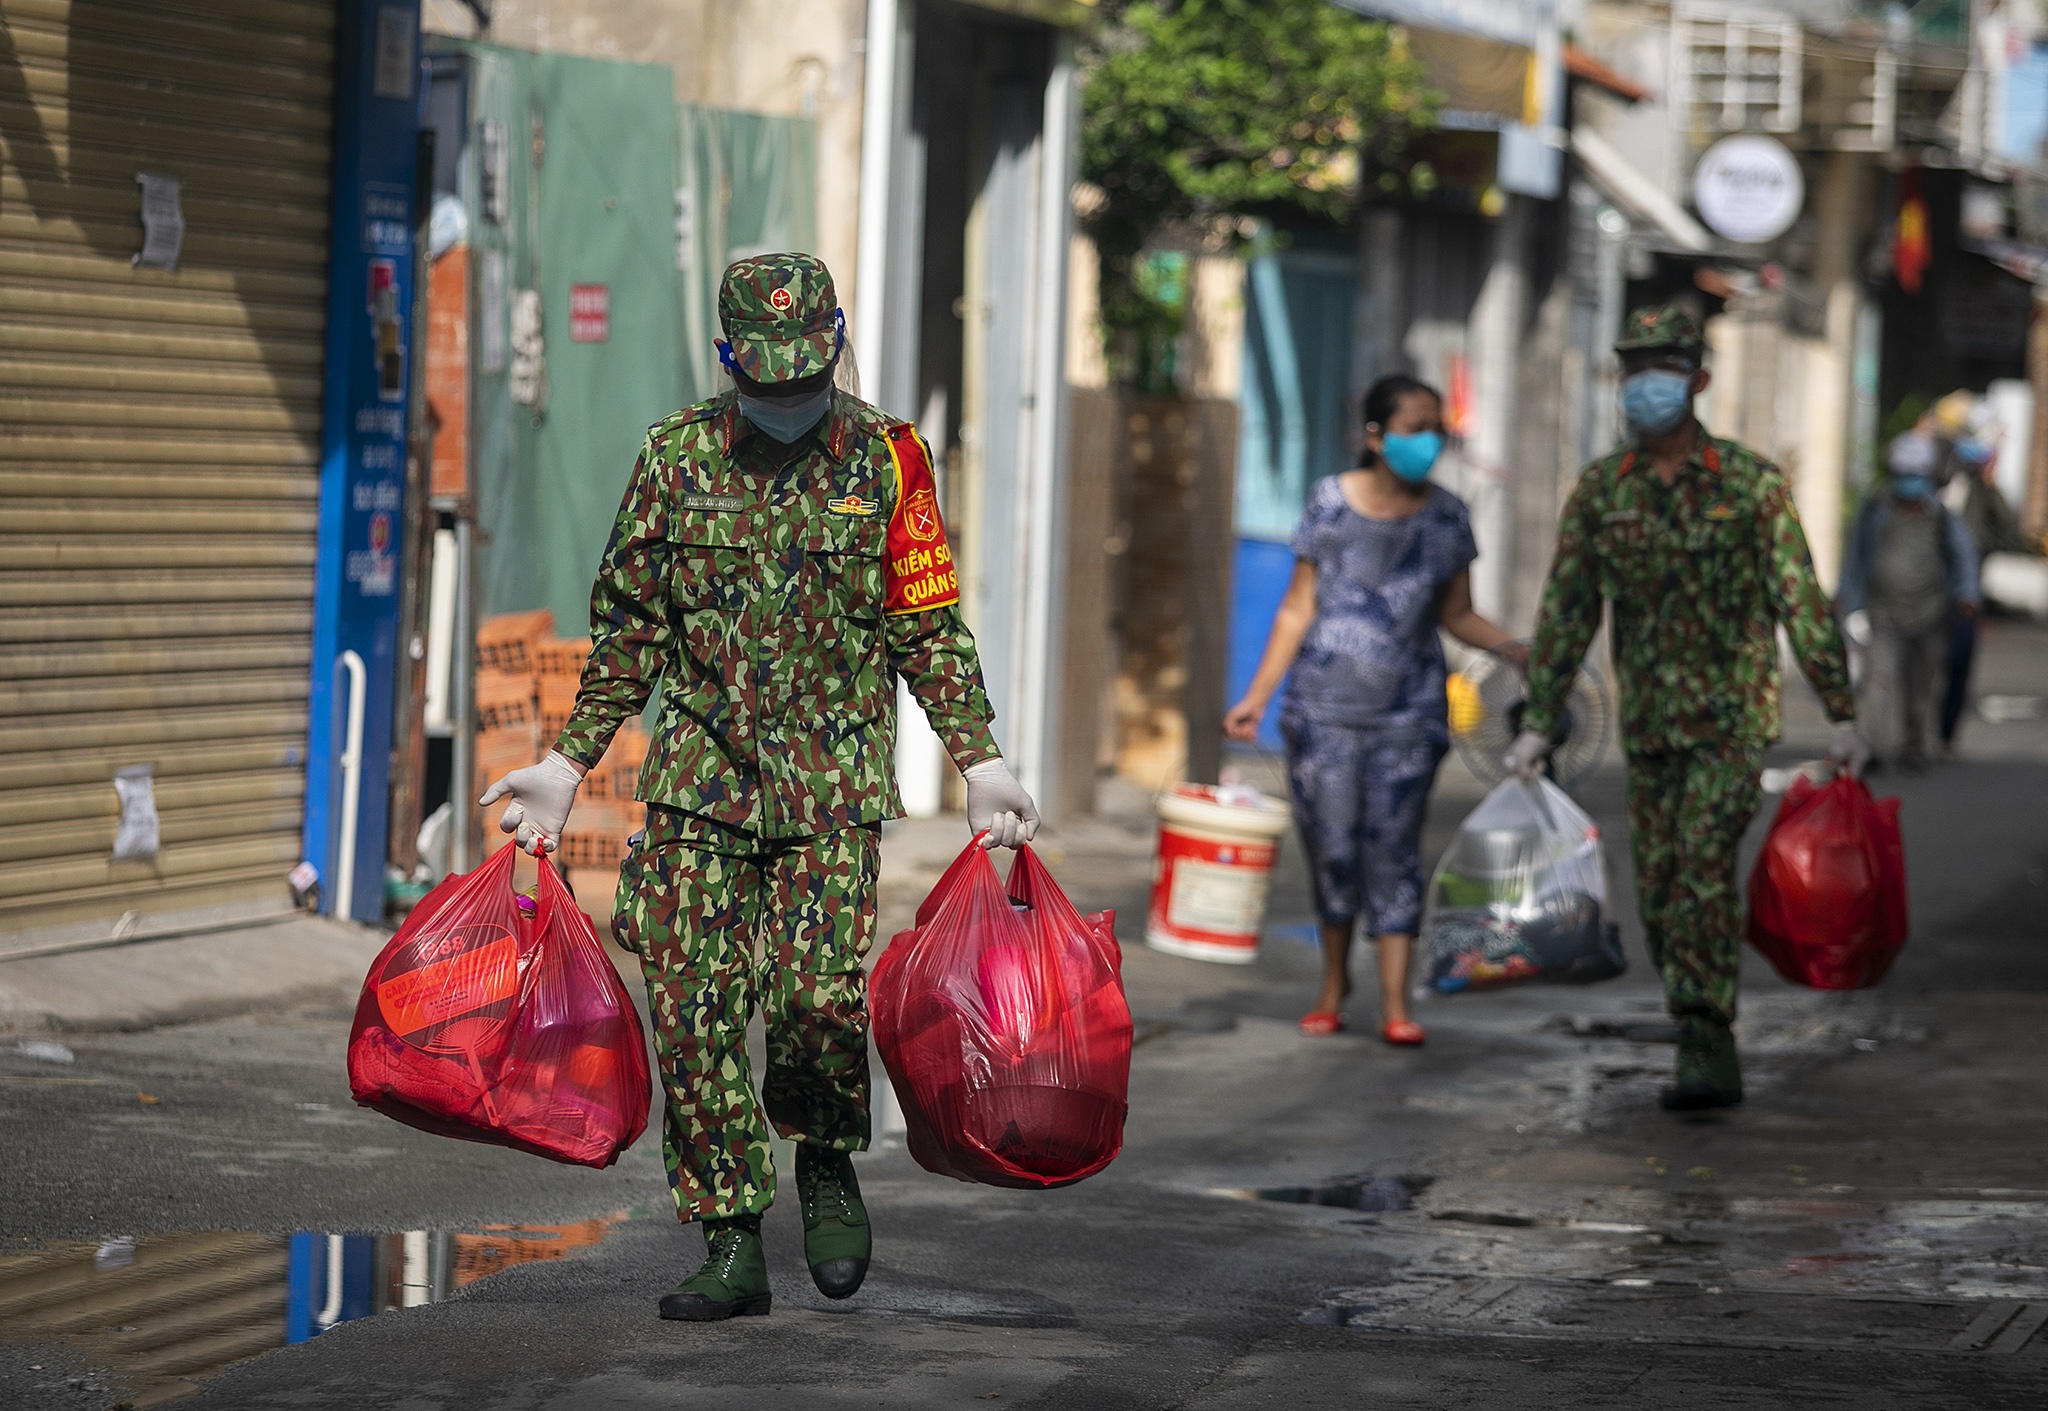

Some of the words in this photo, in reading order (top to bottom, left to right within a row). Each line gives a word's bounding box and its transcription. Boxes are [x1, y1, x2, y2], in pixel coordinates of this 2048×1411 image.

[892, 548, 933, 577] KIỂM
[934, 543, 952, 566] SO
[903, 571, 950, 605] QUÂN
[948, 569, 959, 589] S
